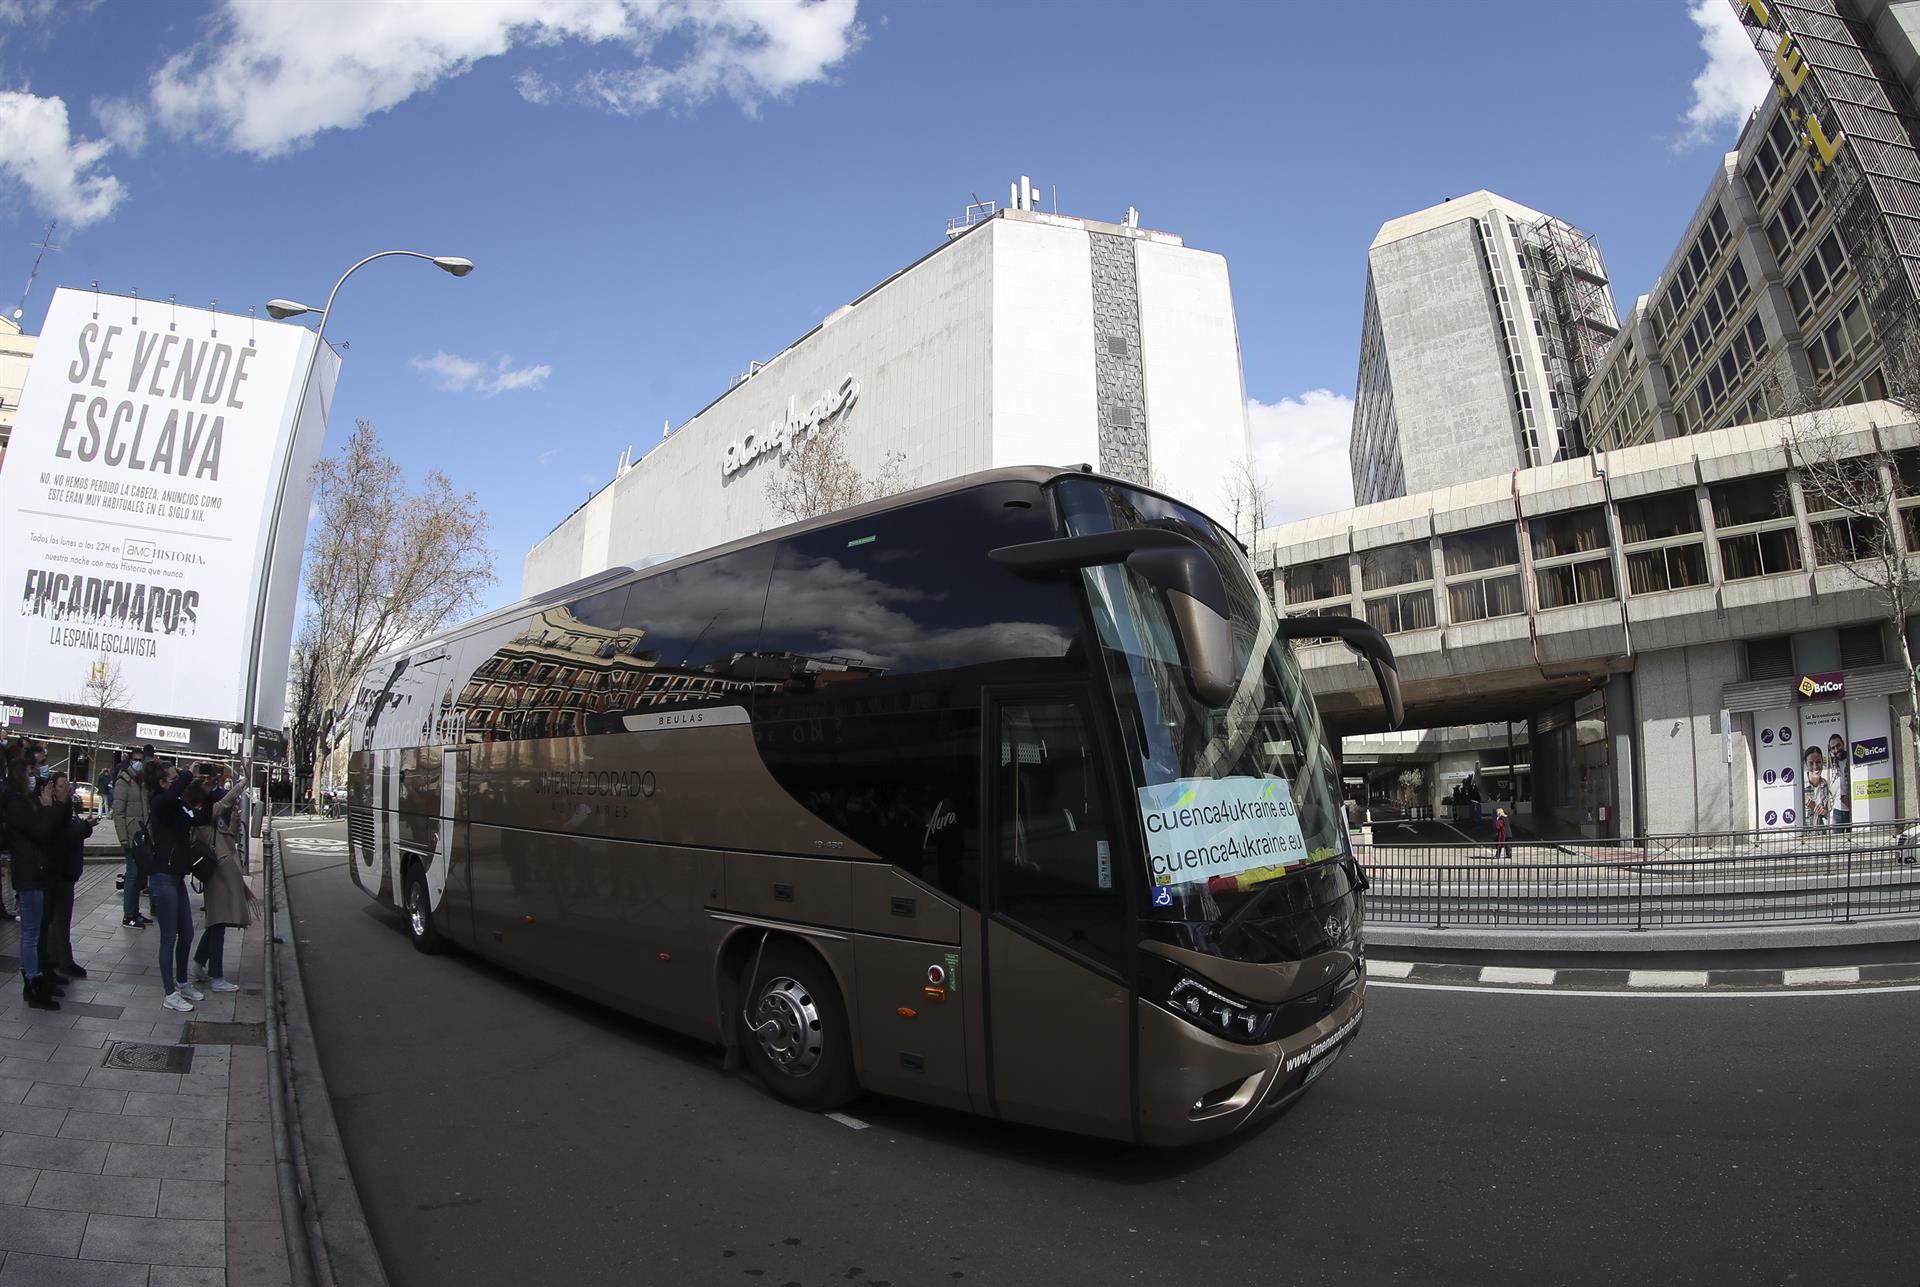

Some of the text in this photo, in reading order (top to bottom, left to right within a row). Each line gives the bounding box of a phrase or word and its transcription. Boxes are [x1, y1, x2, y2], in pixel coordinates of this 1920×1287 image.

[68, 322, 257, 409] SE VENDE
[55, 393, 225, 481] ESCLAVA
[48, 488, 206, 522] ESTE ERAN MUY HABITUALES EN EL SIGLO XIX.
[54, 474, 64, 486] NO
[65, 476, 89, 490] HEMOS
[90, 479, 119, 494] PERDIDO
[120, 483, 130, 495] LA
[131, 484, 159, 500] CABEZA.
[162, 489, 199, 506] ANUNCIOS
[200, 495, 222, 509] COMO
[30, 532, 48, 544] Todos
[49, 535, 59, 545] los
[60, 537, 77, 547] lunes
[85, 540, 94, 550] las
[96, 541, 110, 551] 22H
[45, 553, 69, 562] nuestra
[70, 555, 90, 566] noche
[91, 559, 104, 567] con
[105, 560, 119, 570] más
[120, 563, 146, 574] Historia
[148, 568, 161, 576] que
[22, 569, 199, 636] ENCADENADOS
[50, 626, 157, 658] LA ESPAÑA ESCLAVISTA
[1814, 682, 1843, 693] BriCor
[9, 704, 24, 718] size
[659, 714, 704, 725] BEULAS
[139, 726, 187, 740] PUNT ROMA
[218, 727, 239, 754] Big
[1865, 745, 1887, 756] BriCor
[535, 770, 656, 798] JIMENEZ DORADO
[1147, 797, 1296, 833] cuenca4ukraine.eu
[1152, 833, 1303, 875] cuenca4ukraine.eu
